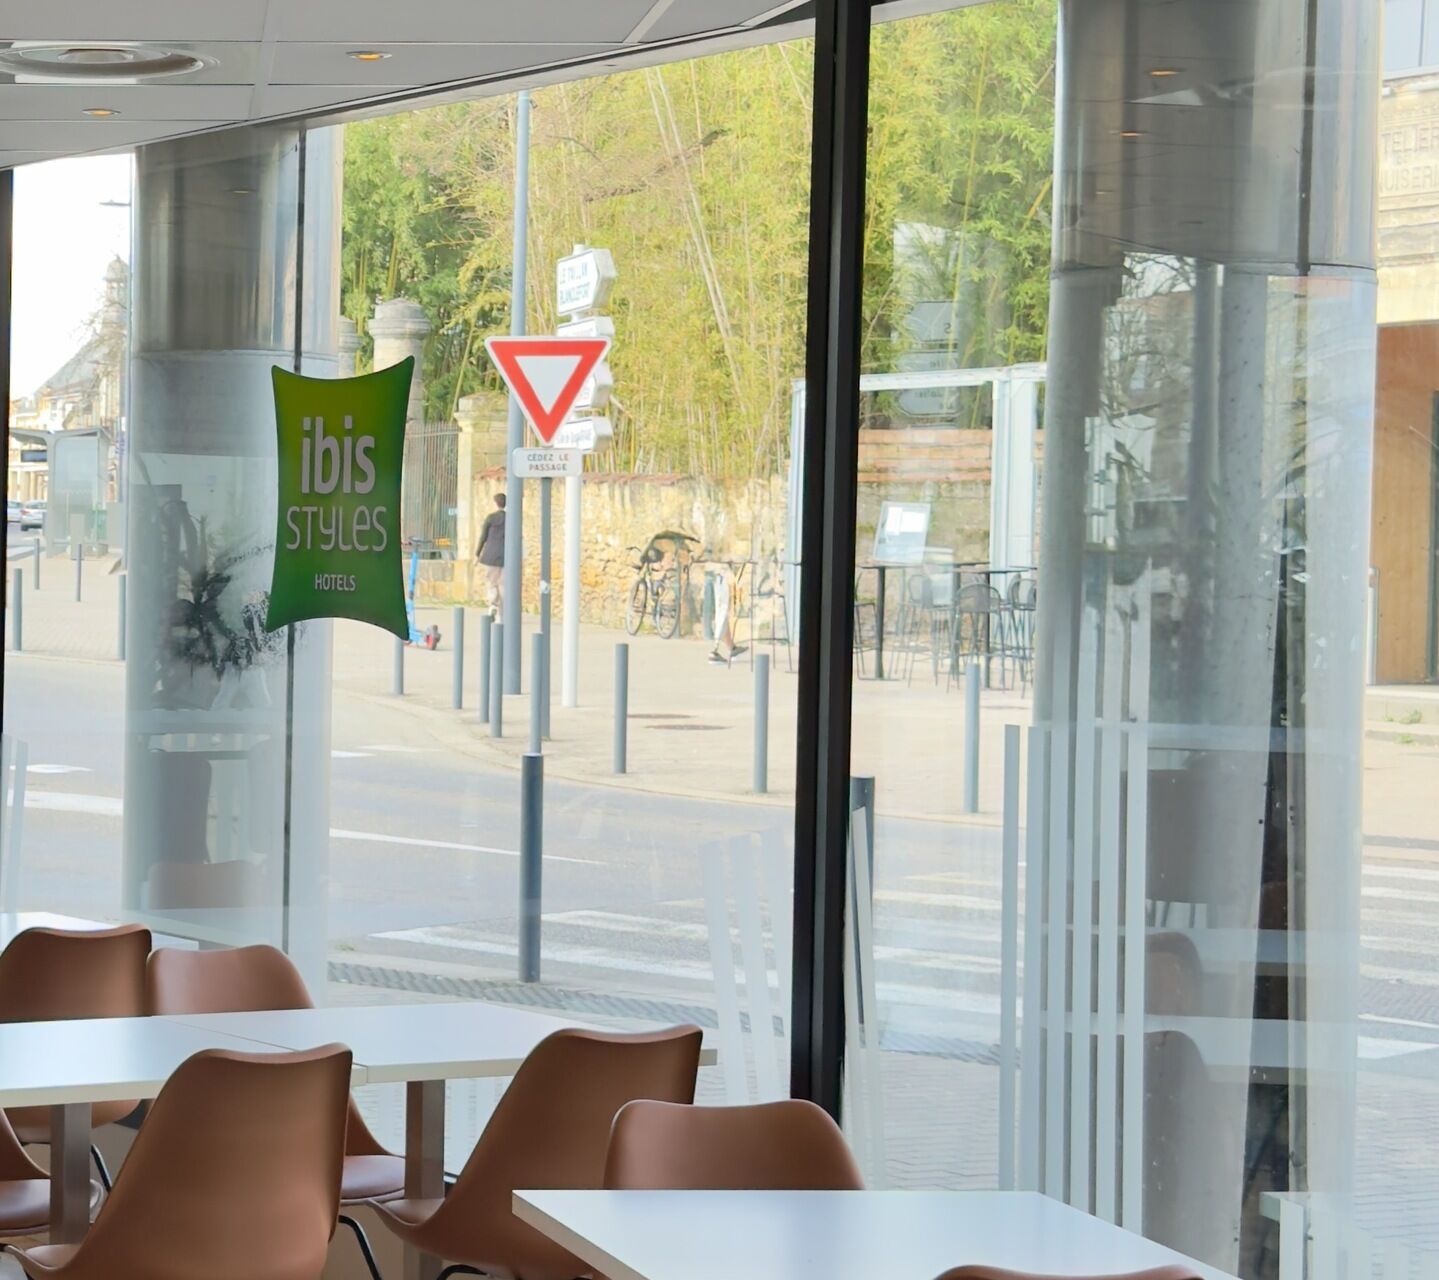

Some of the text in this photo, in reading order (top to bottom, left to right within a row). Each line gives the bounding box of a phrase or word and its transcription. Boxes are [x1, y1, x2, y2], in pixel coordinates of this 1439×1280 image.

[301, 415, 376, 494] ibis
[527, 452, 569, 462] CÉDEZ LE
[528, 463, 568, 472] PASSAGE
[314, 573, 356, 592] HOTELS
